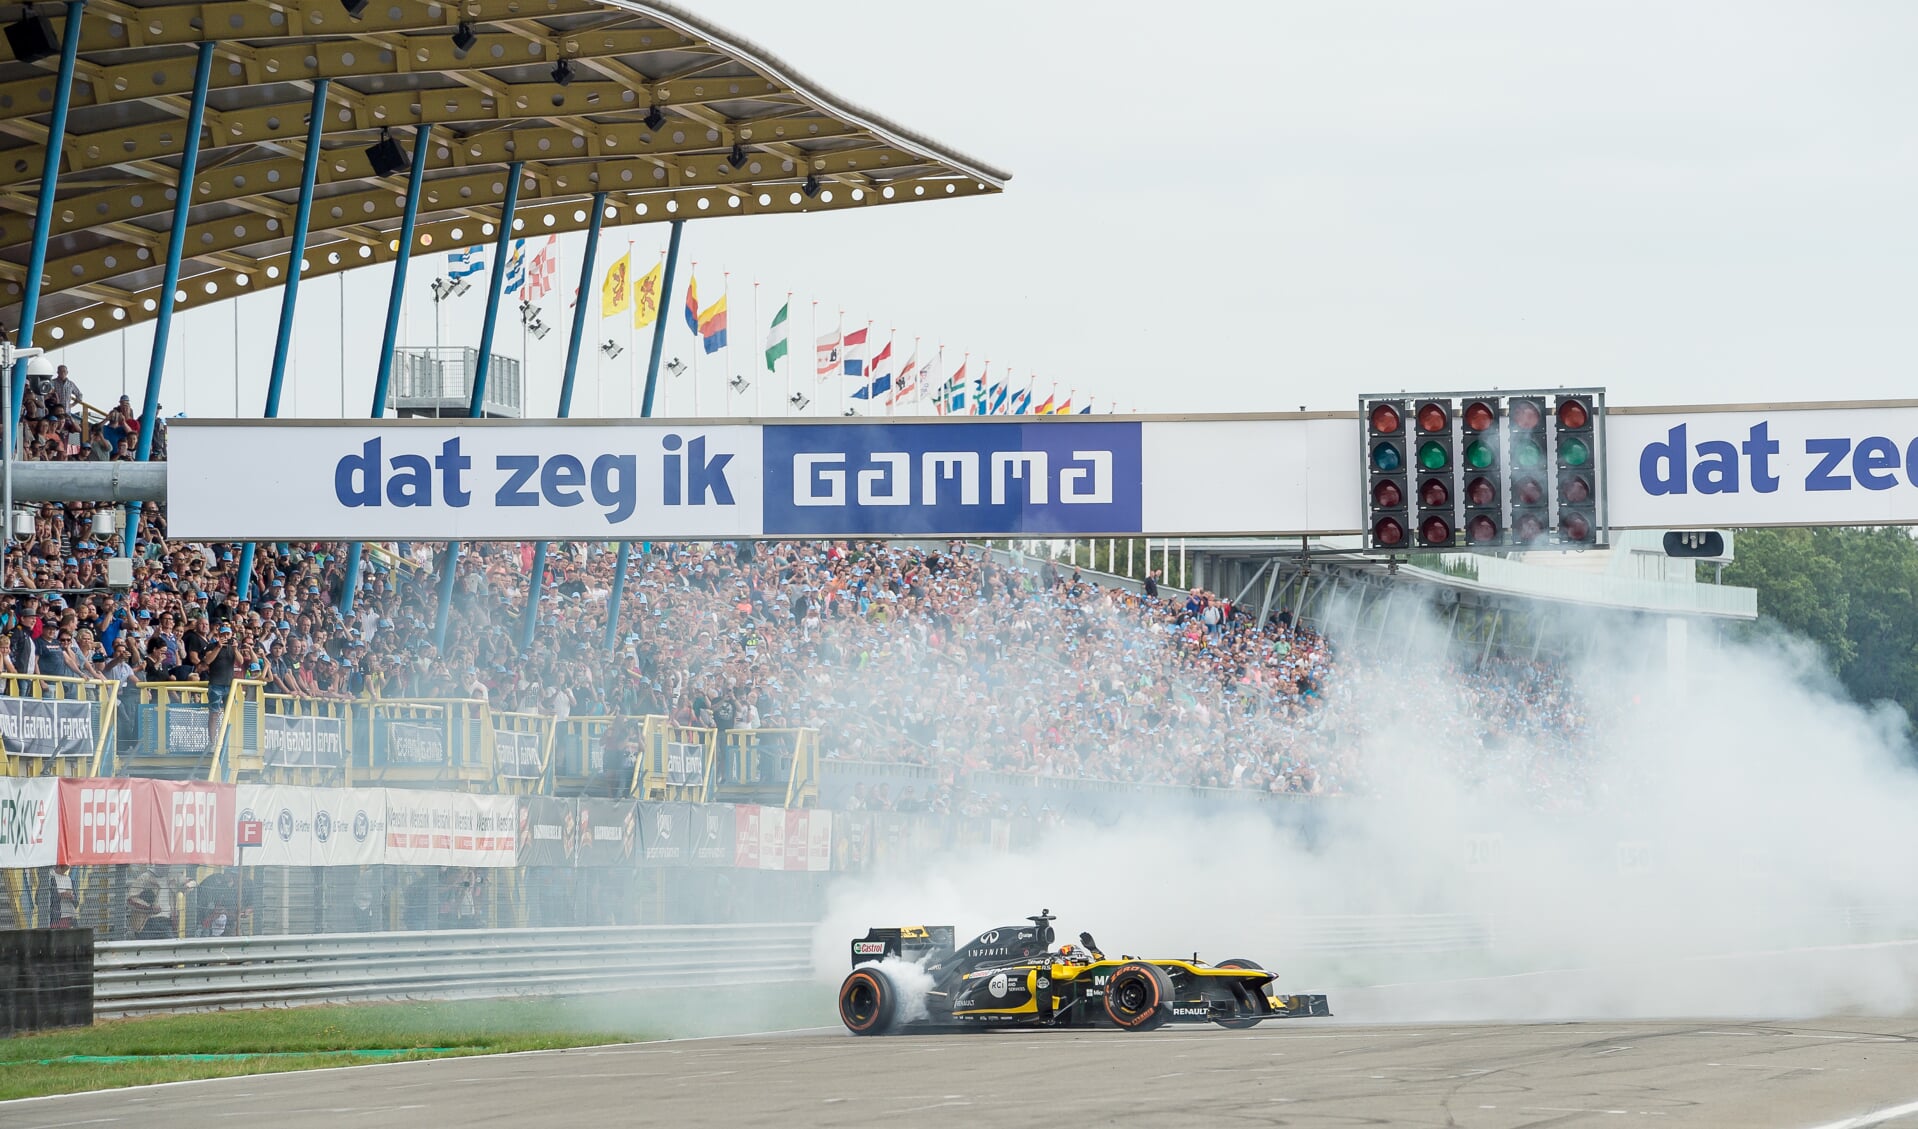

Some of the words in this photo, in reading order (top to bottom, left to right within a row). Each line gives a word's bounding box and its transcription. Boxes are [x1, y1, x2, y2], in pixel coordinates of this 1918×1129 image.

[335, 436, 471, 508] dat
[495, 453, 637, 524] zeg
[662, 434, 736, 505] ik
[1640, 421, 1780, 496] dat
[1805, 436, 1918, 491] ze
[80, 789, 132, 853] FEBO
[171, 791, 216, 853] FEBO
[244, 823, 257, 841] F
[861, 943, 882, 953] Castrol
[968, 947, 1008, 957] INFINITI
